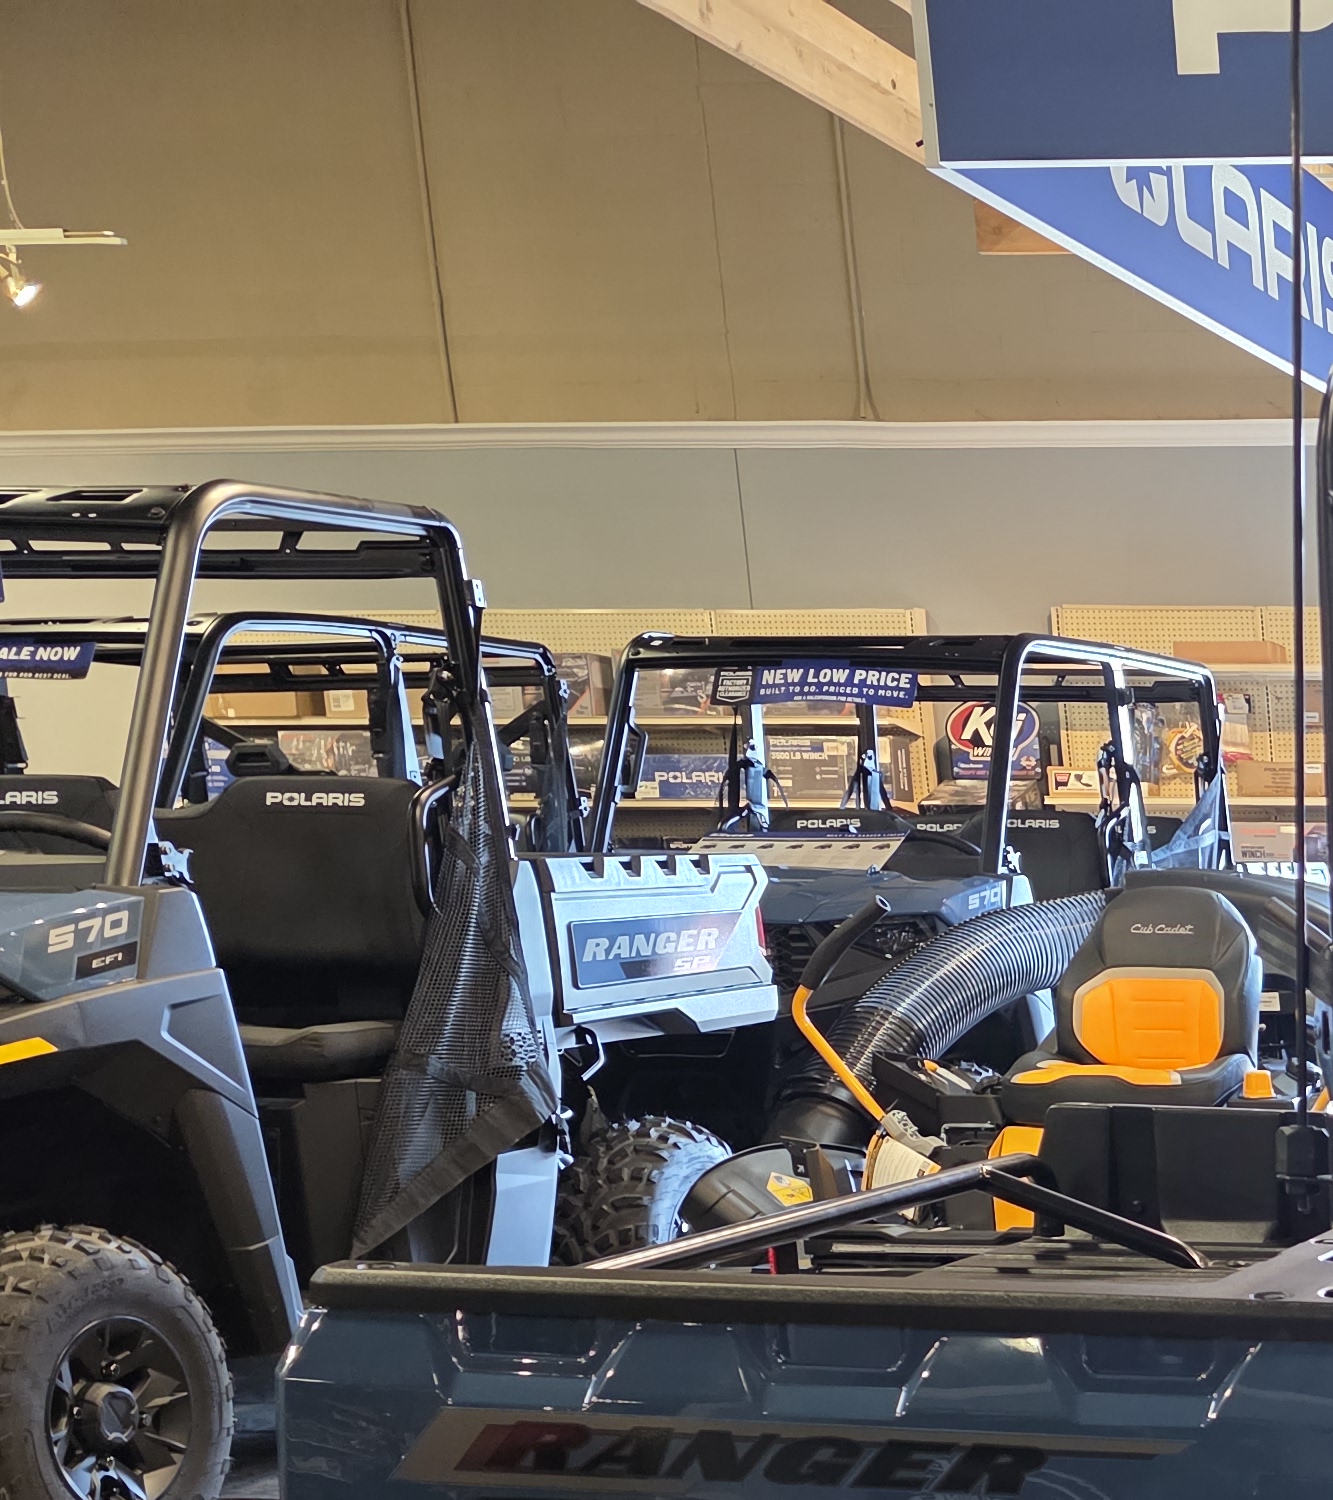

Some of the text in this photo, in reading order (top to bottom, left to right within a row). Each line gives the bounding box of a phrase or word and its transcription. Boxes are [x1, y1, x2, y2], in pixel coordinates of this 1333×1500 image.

[35, 646, 80, 660] NOW
[762, 668, 912, 688] NEW LOW PRICE
[760, 687, 784, 695] BUILT
[823, 686, 858, 694] PRICED
[878, 690, 908, 698] MOVE.
[655, 771, 724, 784] POLARI
[265, 791, 365, 807] POLARIS
[1007, 819, 1060, 829] OLARIS
[1241, 850, 1265, 858] WINCH
[967, 890, 999, 909] 570
[48, 910, 129, 953] 570
[1130, 923, 1194, 935] Cub Cadet
[582, 928, 719, 962] RANGER
[92, 952, 122, 969] EFI
[673, 956, 711, 971] SP
[484, 1420, 1048, 1495] RANGER
